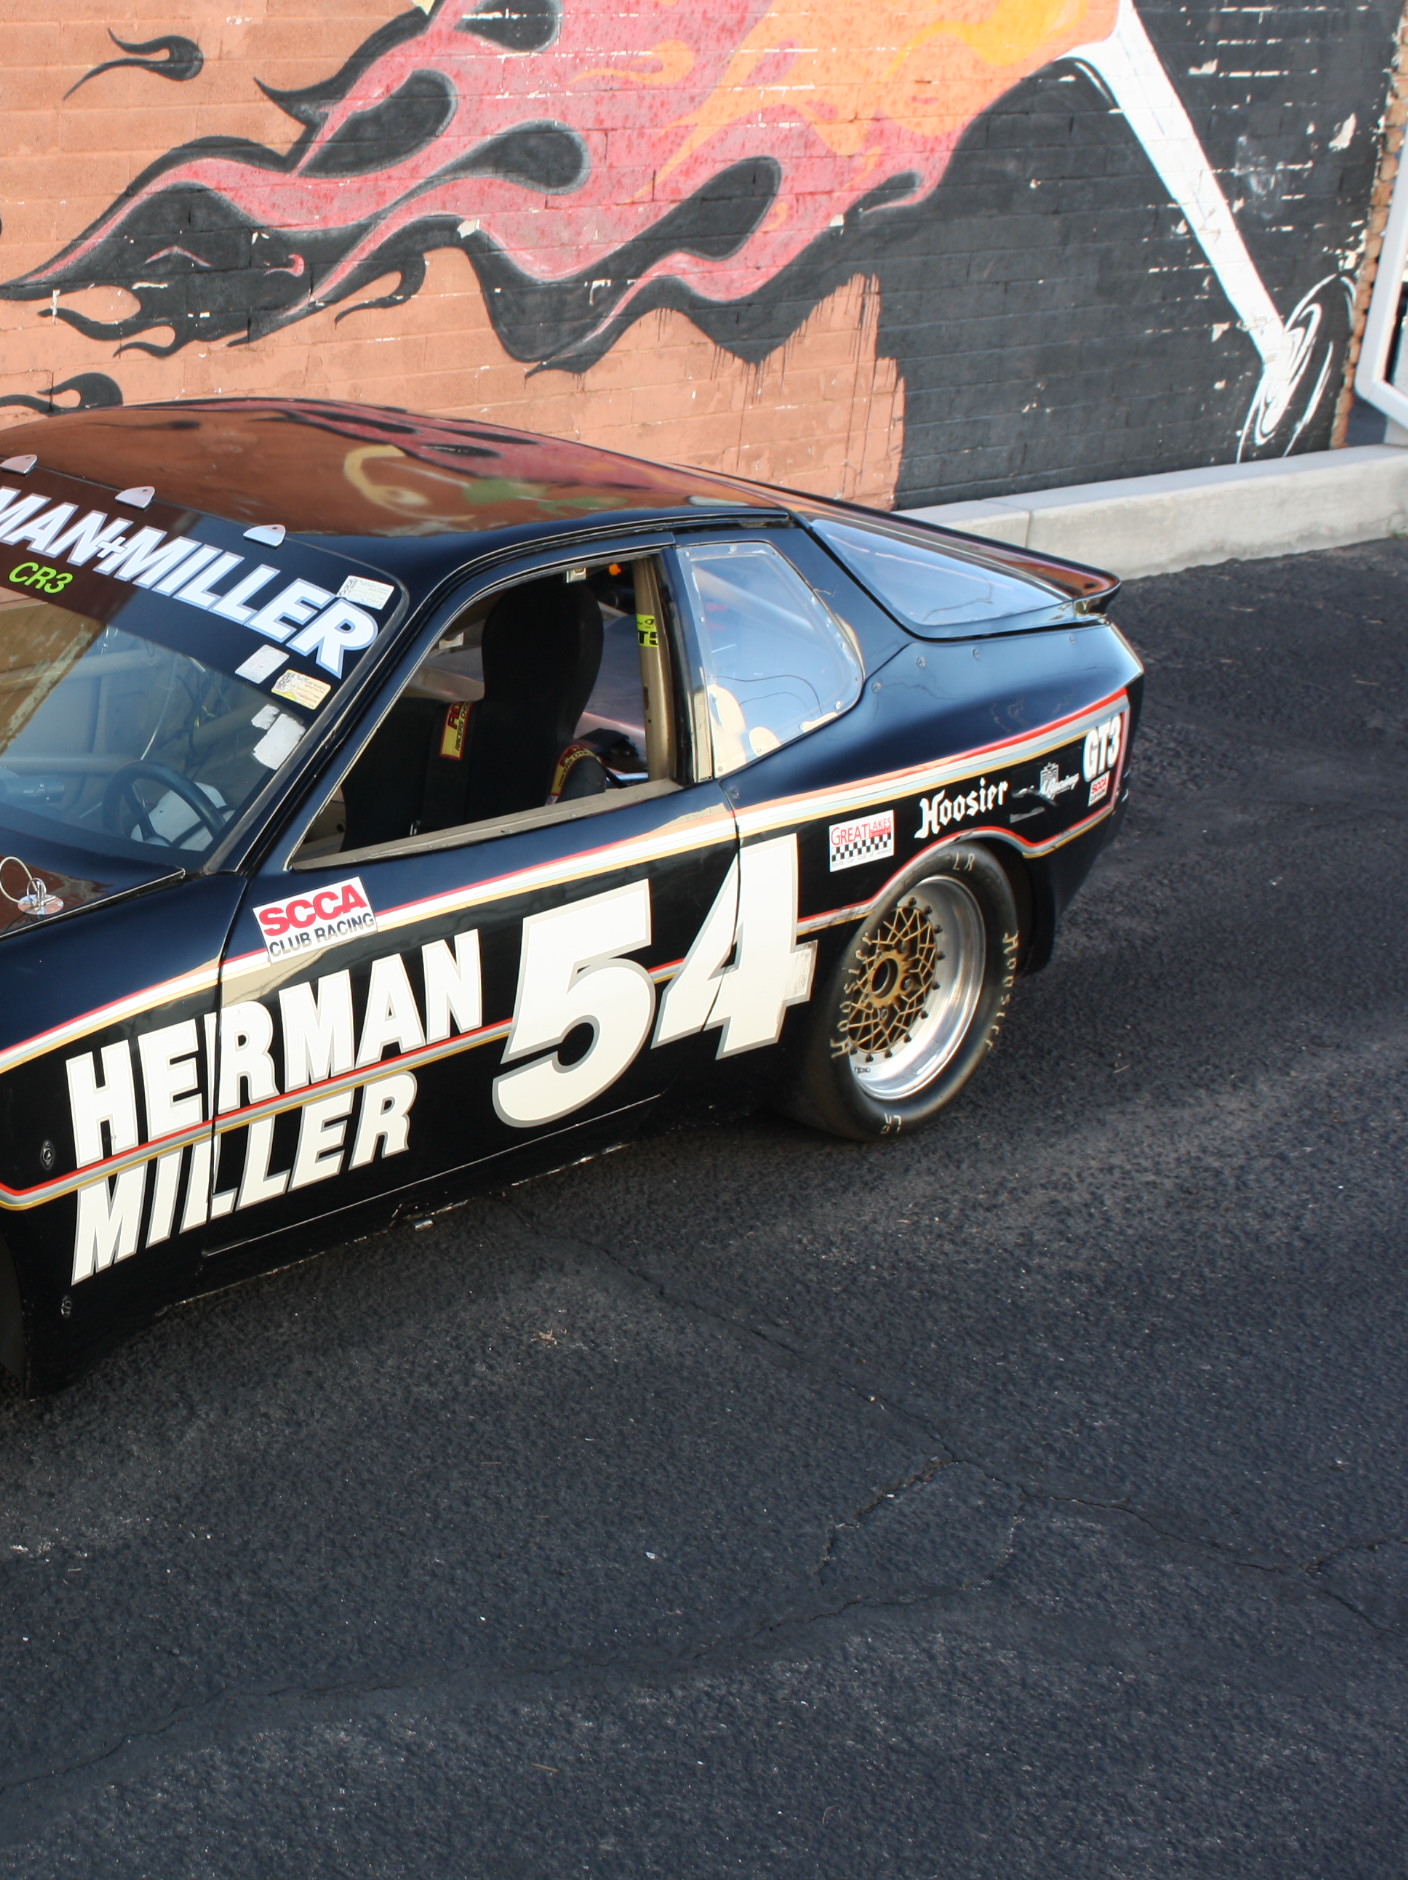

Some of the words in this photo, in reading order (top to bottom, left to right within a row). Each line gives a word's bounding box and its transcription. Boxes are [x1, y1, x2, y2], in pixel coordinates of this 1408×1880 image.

[8, 561, 74, 595] CR3
[1083, 714, 1122, 783] GT3
[914, 776, 1009, 839] Hoosier
[258, 884, 369, 937] SCCA
[269, 931, 312, 957] CLUB
[313, 912, 376, 945] RACING
[492, 833, 818, 1128] 54
[65, 928, 484, 1170] HERMAN
[71, 1070, 419, 1287] MILLER
